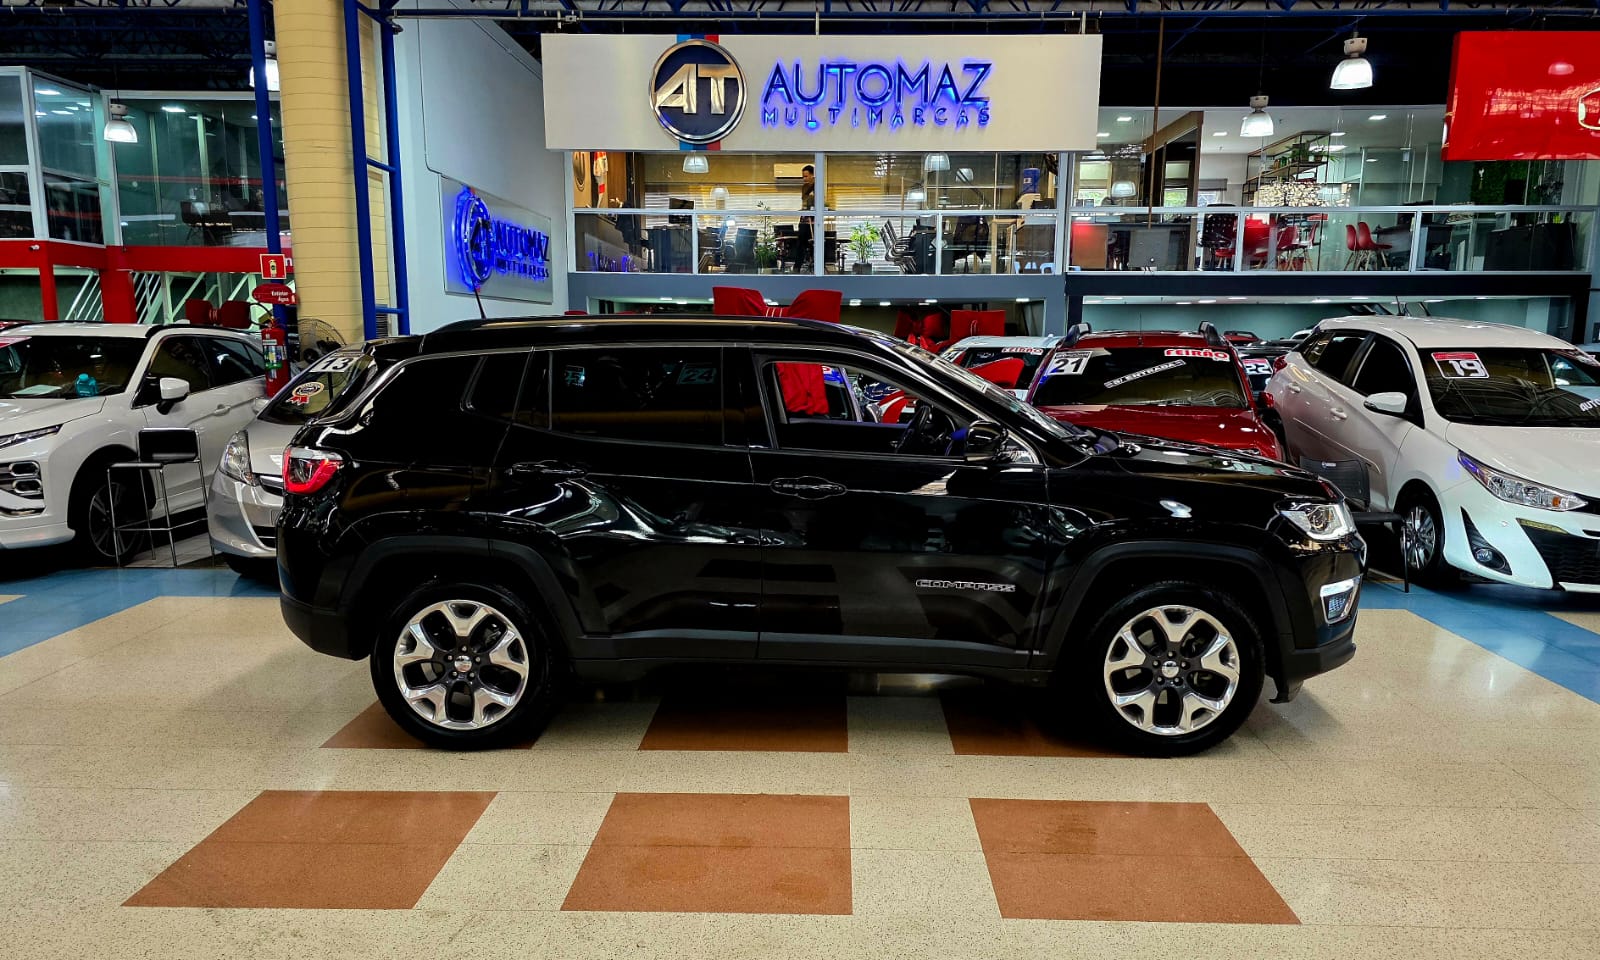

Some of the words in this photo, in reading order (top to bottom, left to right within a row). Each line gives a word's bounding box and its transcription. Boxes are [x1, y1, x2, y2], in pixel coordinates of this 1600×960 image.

[655, 63, 740, 114] AT
[763, 62, 993, 104] AUTOMAZ
[762, 106, 992, 127] MULTIMARCAS
[1164, 348, 1230, 362] FEIRÃO
[321, 357, 354, 370] 13
[1051, 358, 1084, 373] 21
[1448, 359, 1486, 377] 19
[915, 579, 1016, 593] COMPASS
